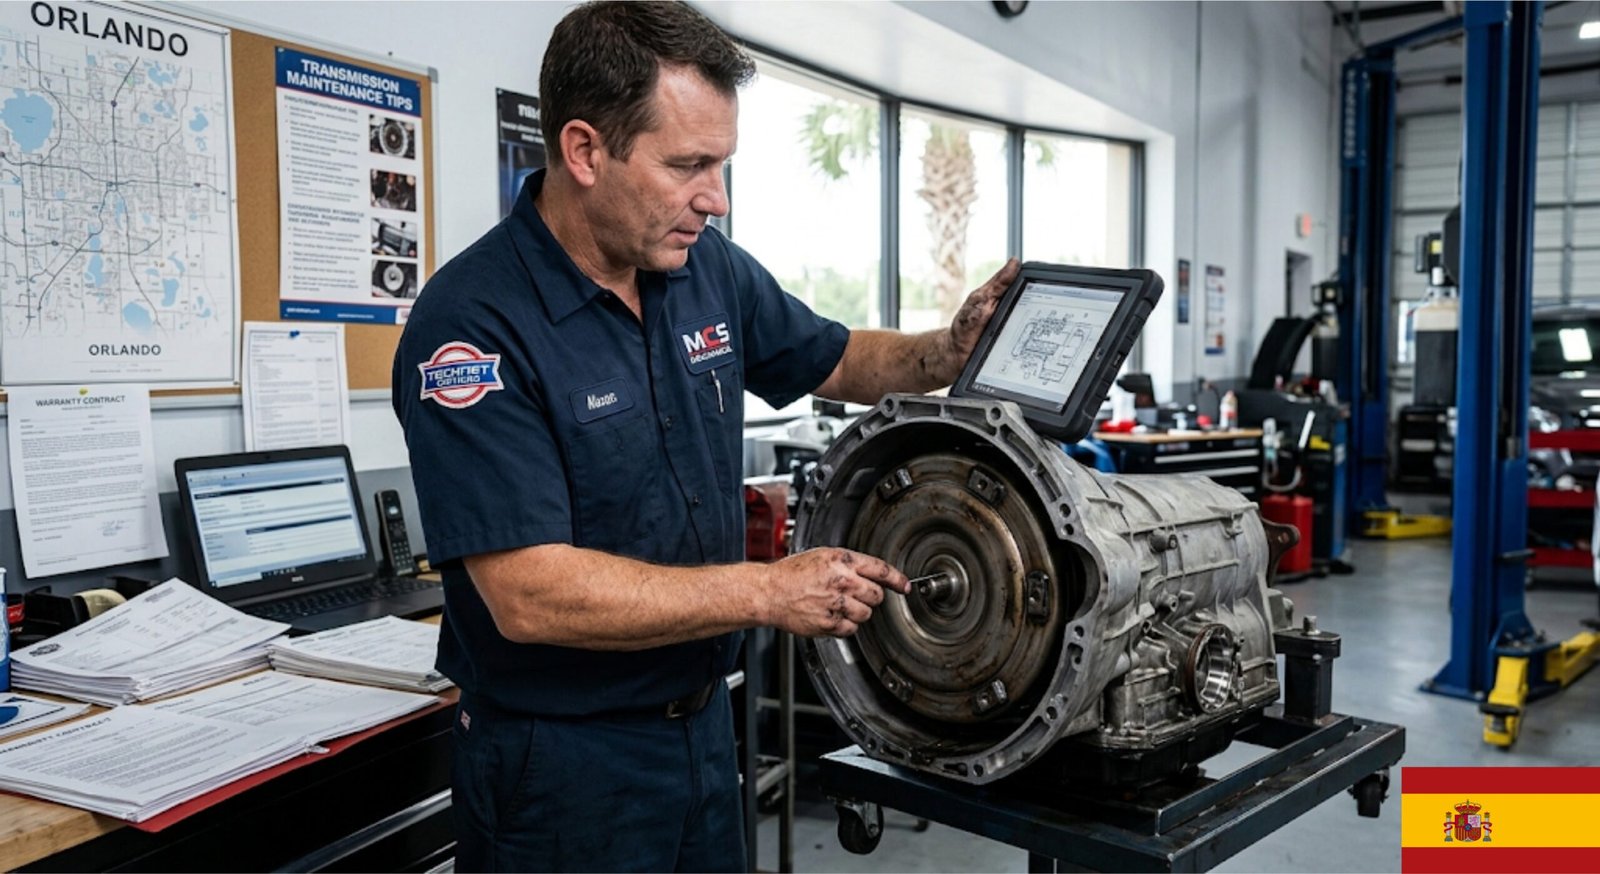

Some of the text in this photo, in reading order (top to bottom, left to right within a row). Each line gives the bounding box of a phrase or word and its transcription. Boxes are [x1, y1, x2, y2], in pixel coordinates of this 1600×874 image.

[31, 1, 188, 57] ORLANDO
[286, 70, 384, 105] MAINTENANCE
[385, 93, 413, 111] TIPS
[301, 59, 400, 94] TRANSMISSION
[88, 344, 162, 356] ORLANDO
[682, 322, 730, 353] MCS
[35, 395, 126, 407] WARRANTY CONTRACT
